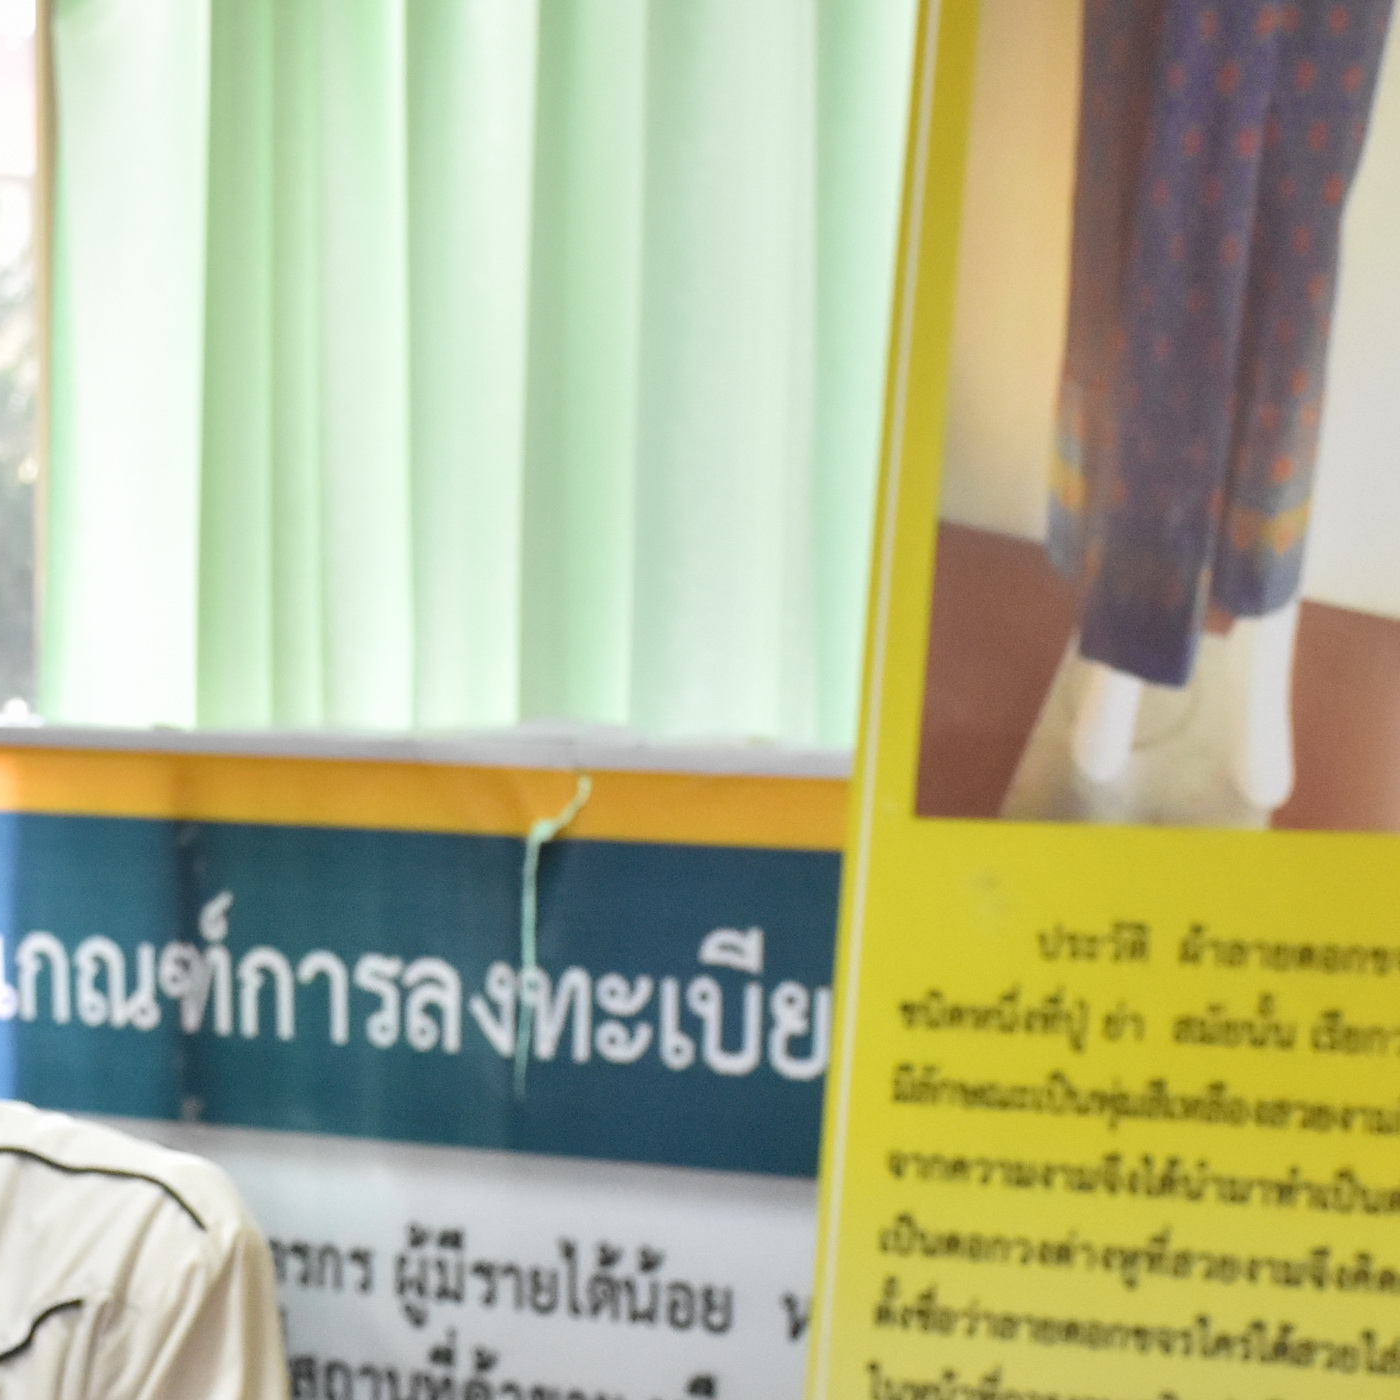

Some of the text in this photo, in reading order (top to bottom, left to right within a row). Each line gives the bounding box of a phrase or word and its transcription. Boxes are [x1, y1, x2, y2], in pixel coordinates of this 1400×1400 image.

[394, 1220, 735, 1336] ผู้มีรายได้น้อย
